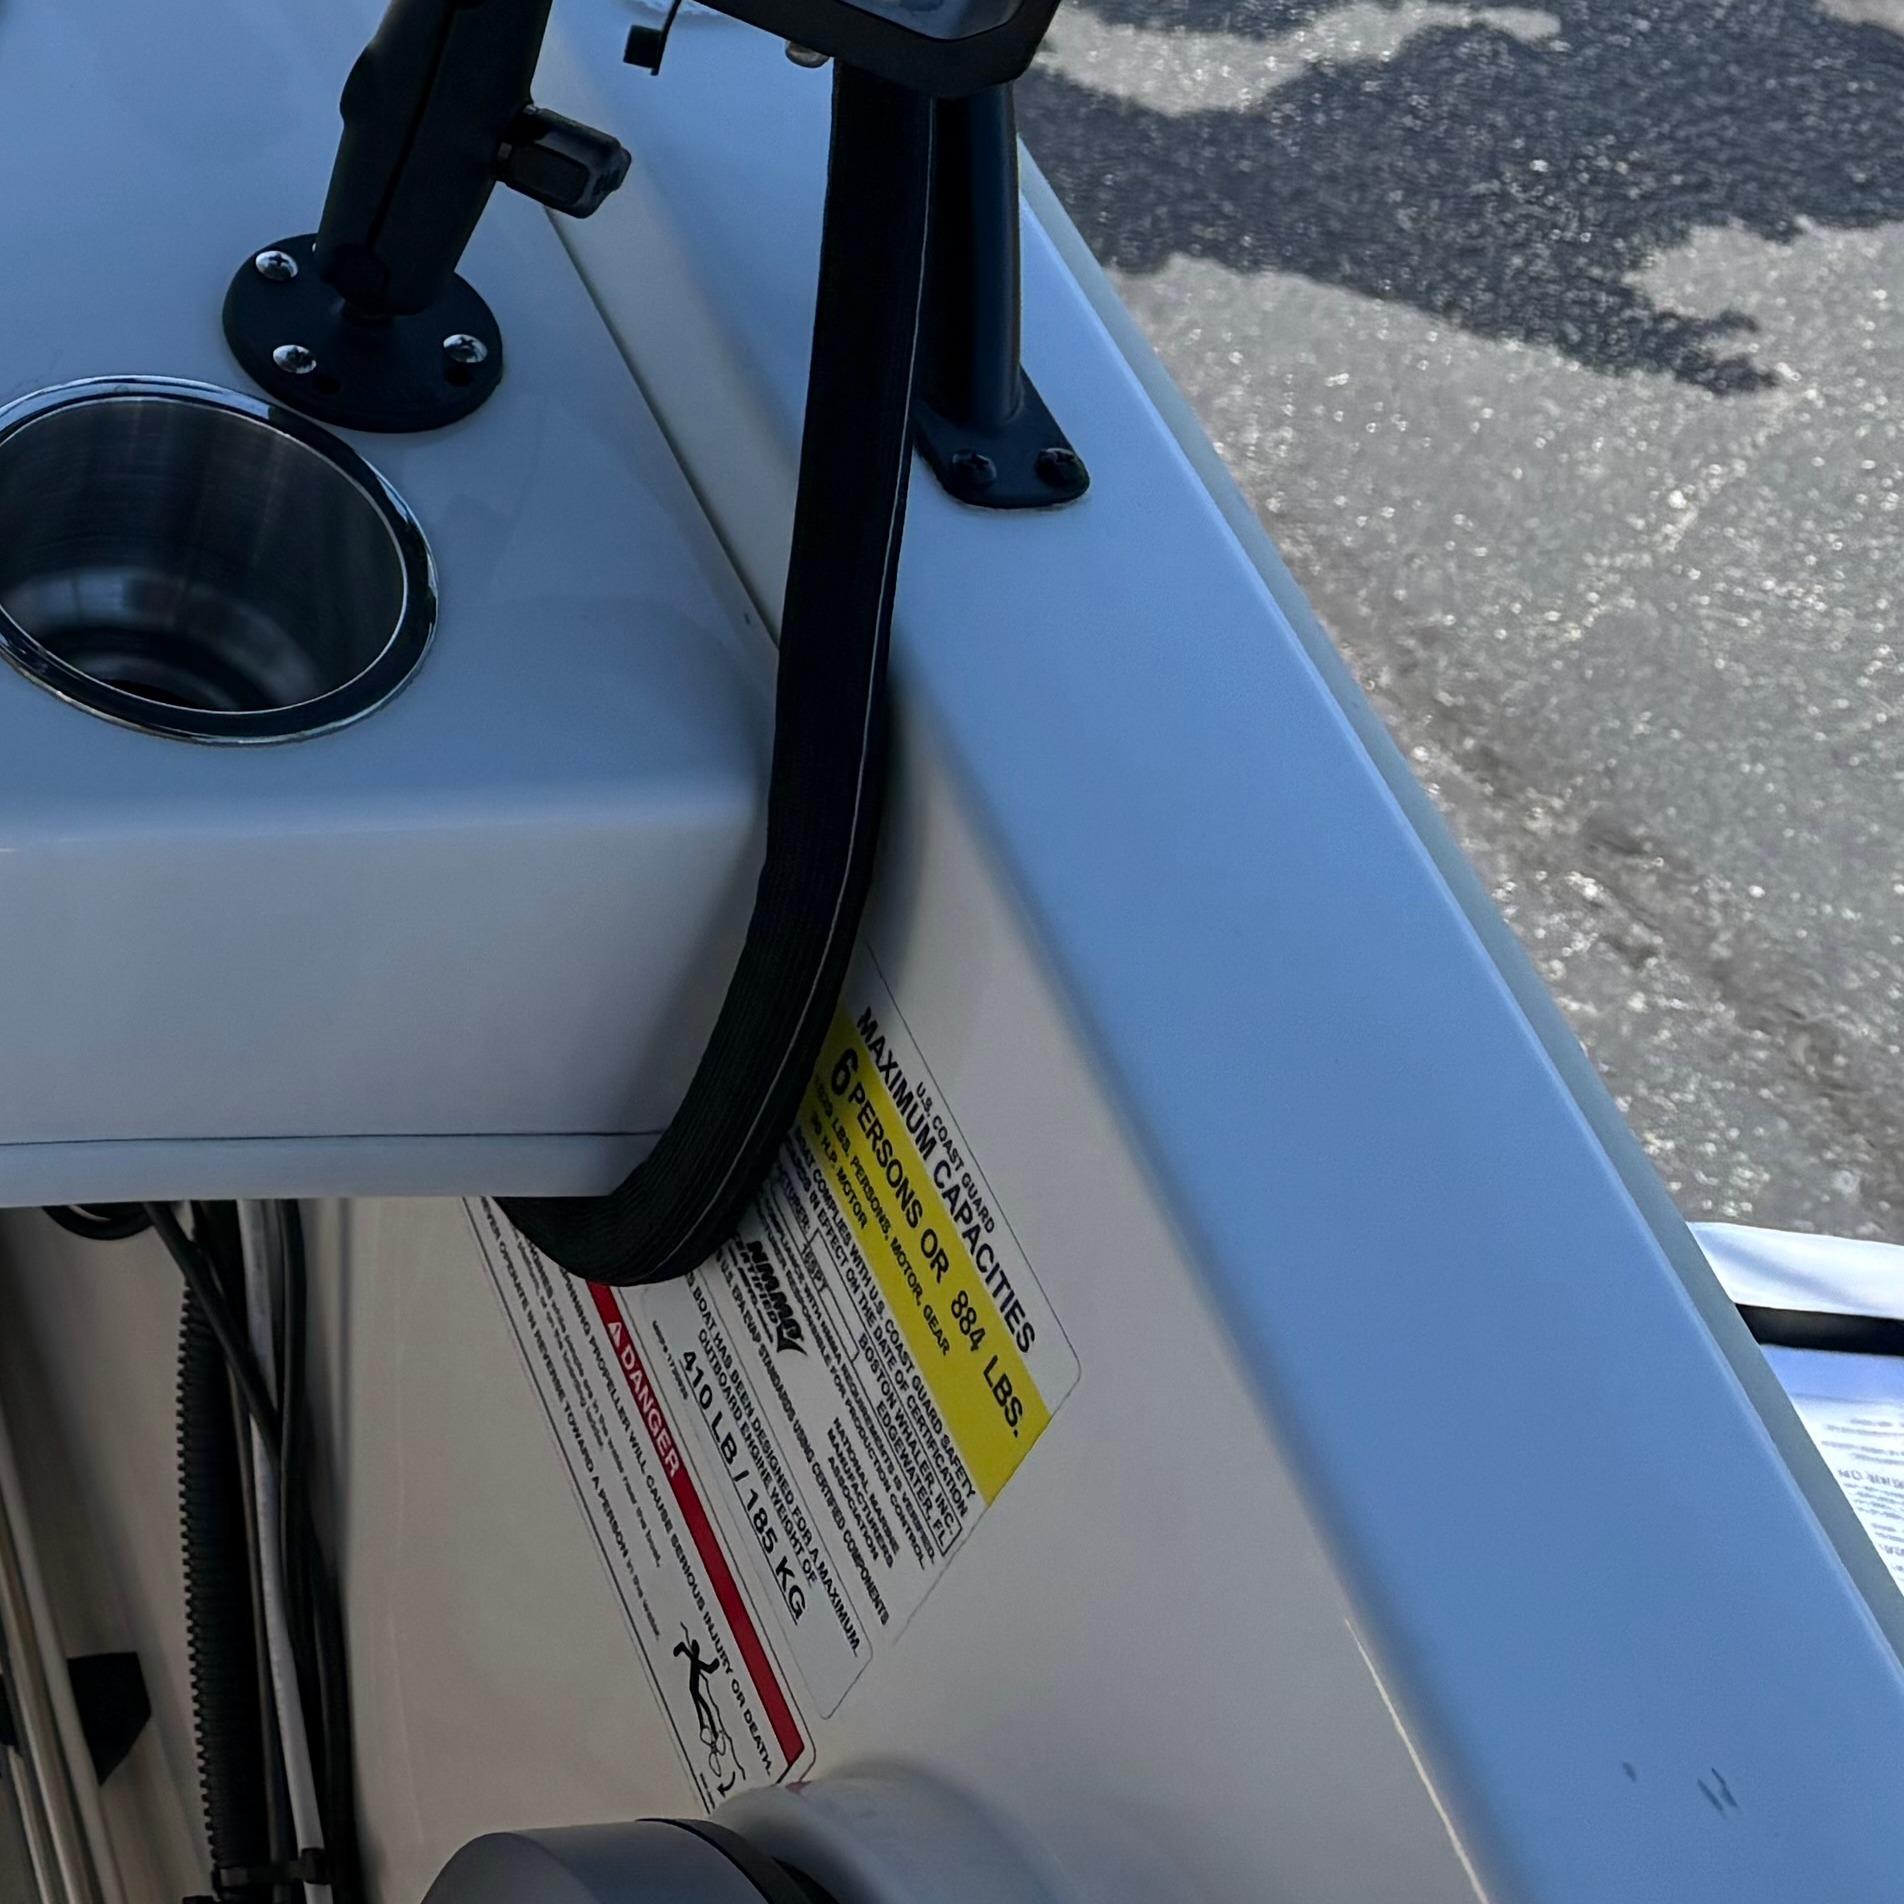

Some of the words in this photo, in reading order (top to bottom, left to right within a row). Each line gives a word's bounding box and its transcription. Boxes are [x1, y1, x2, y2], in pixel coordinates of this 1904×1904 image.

[834, 1166, 869, 1230] MOTOR
[854, 1006, 937, 1160] MAXIMUM
[931, 1156, 1036, 1356] CAPACITIES
[914, 1081, 935, 1117] U.S.
[931, 1114, 963, 1172] COAST
[959, 1170, 995, 1235] GUARD
[830, 1046, 860, 1097] 6
[846, 1082, 924, 1229] PERSONS
[918, 1225, 951, 1284] OR
[949, 1287, 986, 1354] 884
[982, 1353, 1028, 1439] LBS.
[889, 1236, 926, 1306] MOTOR,
[921, 1302, 951, 1357] GEAR
[618, 1343, 682, 1479] DANGER
[811, 1167, 853, 1247] COMPLIES
[848, 1243, 872, 1288] WITH
[883, 1316, 914, 1375] COAST
[910, 1373, 943, 1436] GUARD
[939, 1432, 975, 1502] SAFETY
[816, 1209, 848, 1269] EFFECT
[844, 1266, 861, 1295] ON
[855, 1289, 877, 1328] THE
[872, 1324, 898, 1372] DATE
[893, 1366, 910, 1396] OF
[906, 1392, 968, 1518] CERTIFICATION
[562, 1401, 596, 1474] TOWARD
[596, 1484, 630, 1559] PERSON
[680, 1345, 715, 1411] 410
[708, 1408, 740, 1467] LB
[742, 1484, 779, 1556] 185
[773, 1553, 808, 1622] KG
[691, 1284, 717, 1333] BOAT
[712, 1329, 734, 1370] HAS
[729, 1367, 755, 1418] BEEN
[750, 1415, 795, 1508] DESIGNED
[790, 1503, 813, 1548] FOR
[816, 1558, 861, 1653] MAXIMUM
[697, 1327, 743, 1423] OUTBOARD
[739, 1420, 773, 1489] ENGINE
[767, 1484, 804, 1560] WEIGHT
[800, 1555, 817, 1588] OF
[826, 1425, 894, 1570] MANUFACTURERS
[827, 1452, 879, 1562] ASSOCIATION
[843, 1395, 891, 1494] PRODUCTION
[857, 1331, 897, 1410] BOSTON
[893, 1407, 937, 1495] WHALER,
[934, 1491, 957, 1536] INC.
[875, 1398, 936, 1522] EDGEWATER,
[932, 1517, 948, 1547] FL
[587, 1333, 632, 1432] PROPELLER
[627, 1429, 649, 1474] WILL
[644, 1472, 674, 1534] CAUSE
[669, 1531, 706, 1612] SERIOUS
[701, 1608, 734, 1678] INJURY
[729, 1676, 746, 1709] OR
[742, 1705, 776, 1778] DEATH.
[842, 1526, 890, 1627] COMPONENTS
